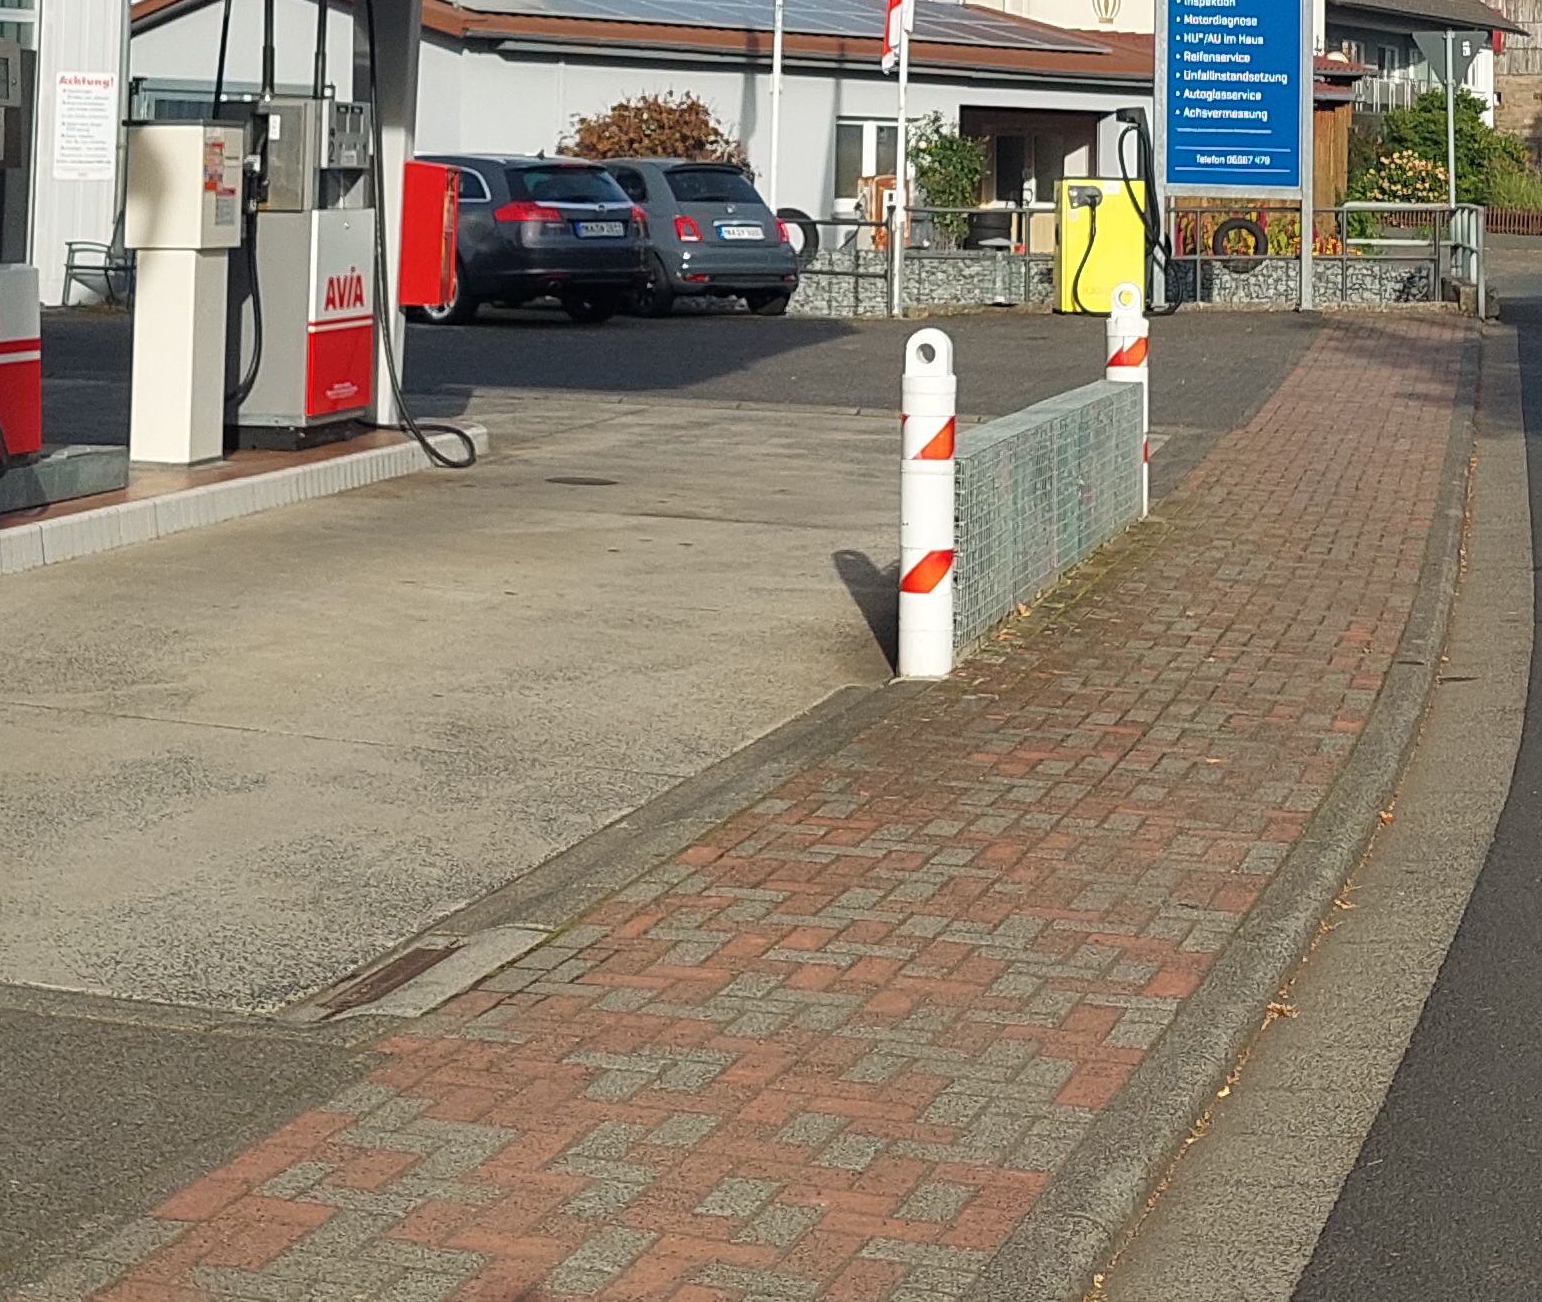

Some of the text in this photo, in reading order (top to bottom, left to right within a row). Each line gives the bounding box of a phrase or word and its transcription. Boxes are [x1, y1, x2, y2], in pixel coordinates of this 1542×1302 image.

[1183, 13, 1258, 28] Motordiagnose
[1238, 33, 1264, 45] Haus
[1183, 50, 1251, 63] Reifenservice
[59, 75, 114, 89] Achtung!
[1183, 69, 1288, 85] Unfallinstandsetzung
[1183, 88, 1262, 102] Autoglasservice
[1183, 107, 1268, 122] Achsvermessung
[1196, 153, 1225, 164] Telefon
[324, 266, 364, 311] AVIA
